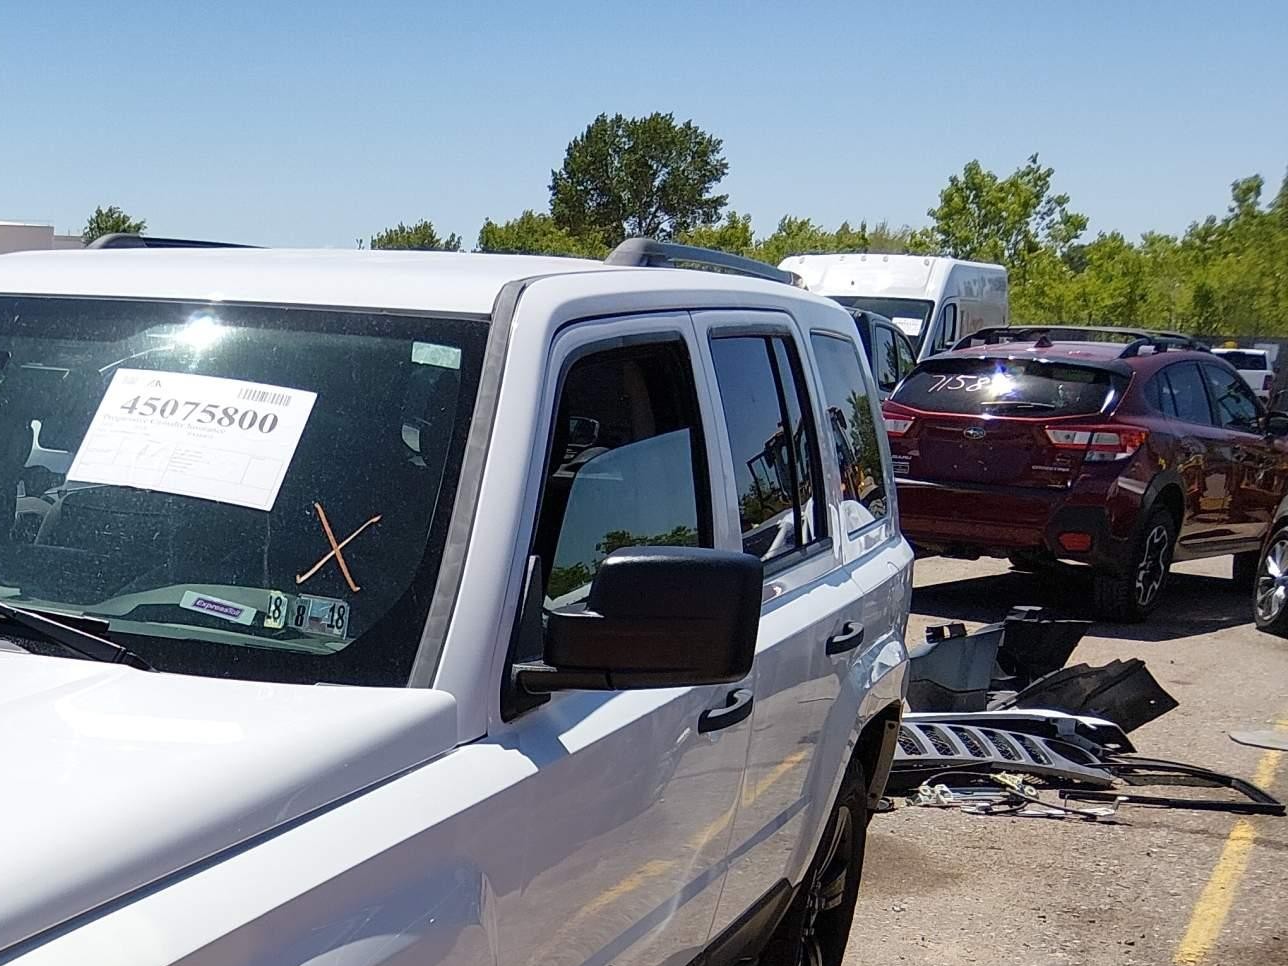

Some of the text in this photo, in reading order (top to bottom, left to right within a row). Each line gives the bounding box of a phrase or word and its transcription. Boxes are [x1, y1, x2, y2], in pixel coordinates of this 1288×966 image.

[120, 395, 279, 434] 45075800
[266, 595, 283, 620] 18
[294, 603, 346, 630] 8 18
